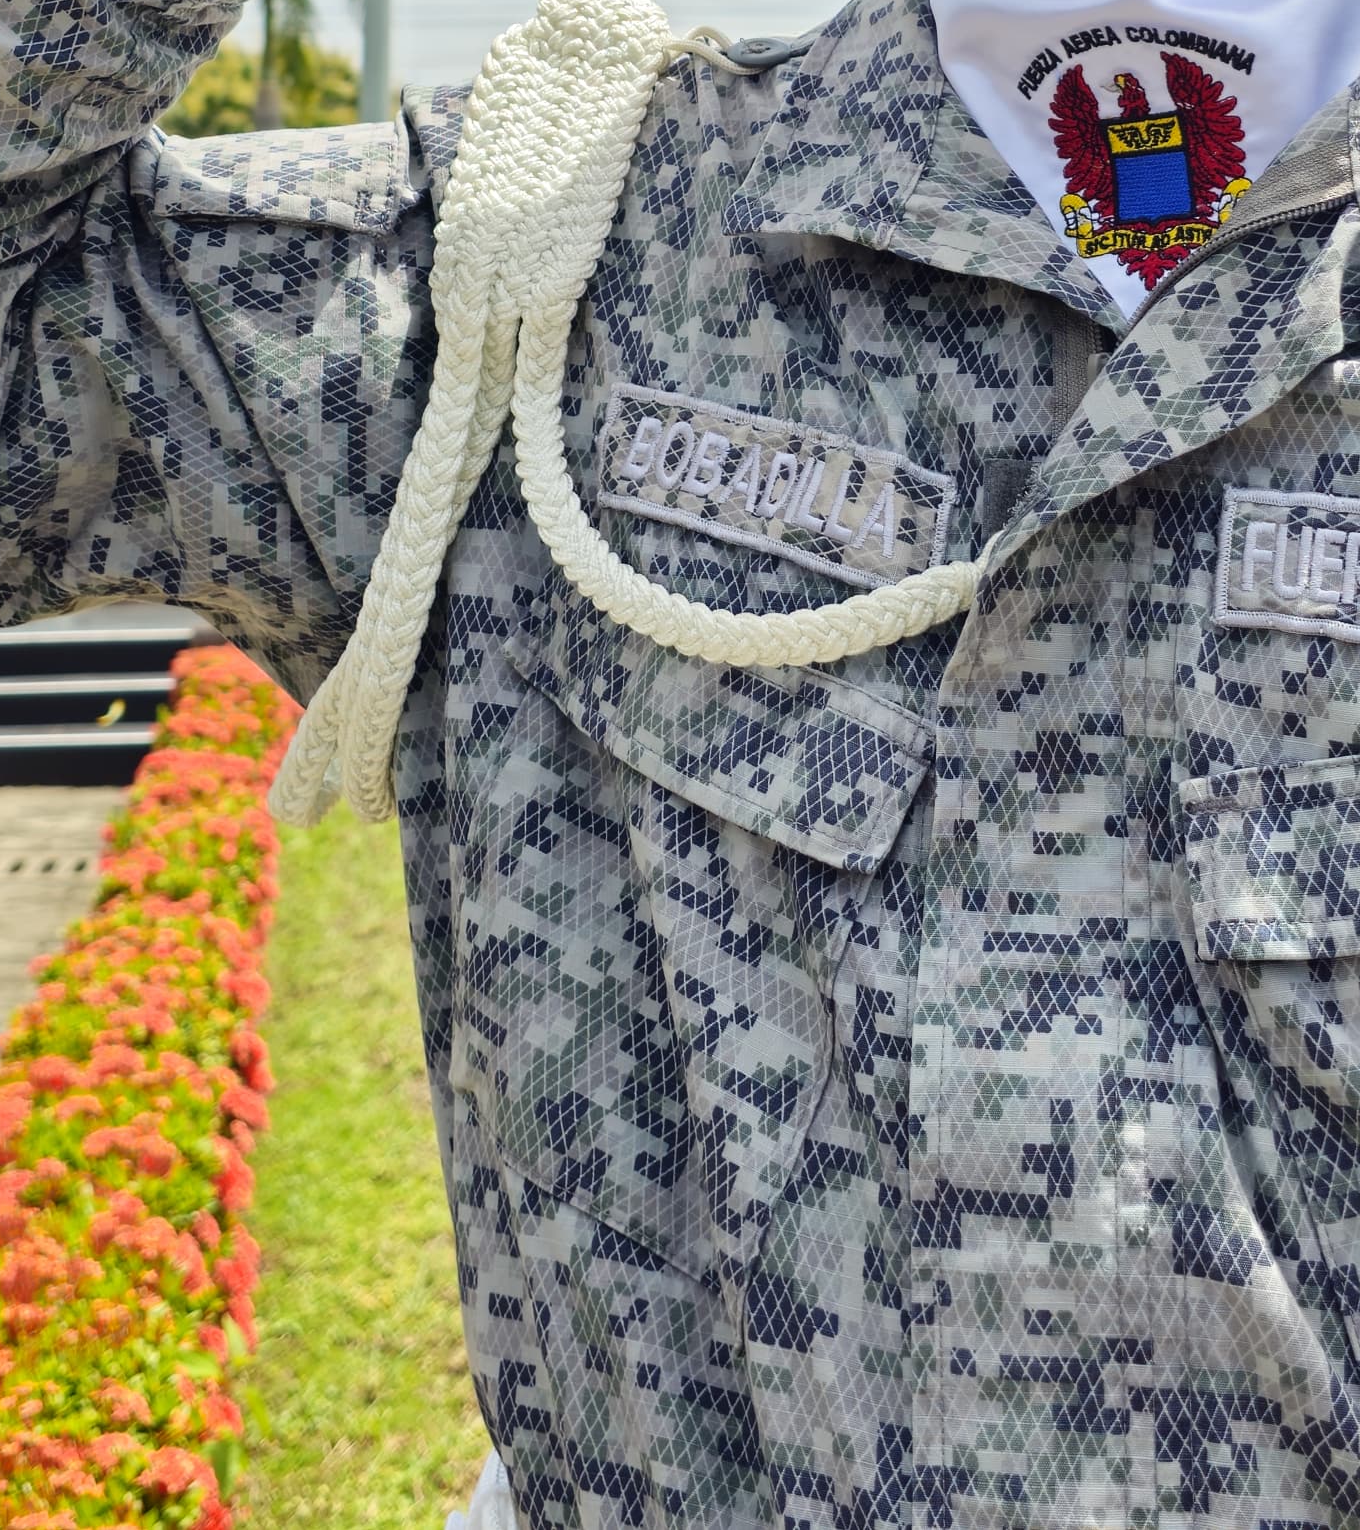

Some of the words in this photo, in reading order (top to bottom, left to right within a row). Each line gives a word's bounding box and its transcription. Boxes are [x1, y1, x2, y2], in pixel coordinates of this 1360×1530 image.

[1017, 47, 1062, 100] FUERZA
[1060, 26, 1122, 59] AEREA
[1125, 26, 1256, 76] COLOMBIANA
[1151, 233, 1171, 249] AD
[1174, 227, 1214, 243] ASTR
[621, 416, 898, 560] BOBADILLA
